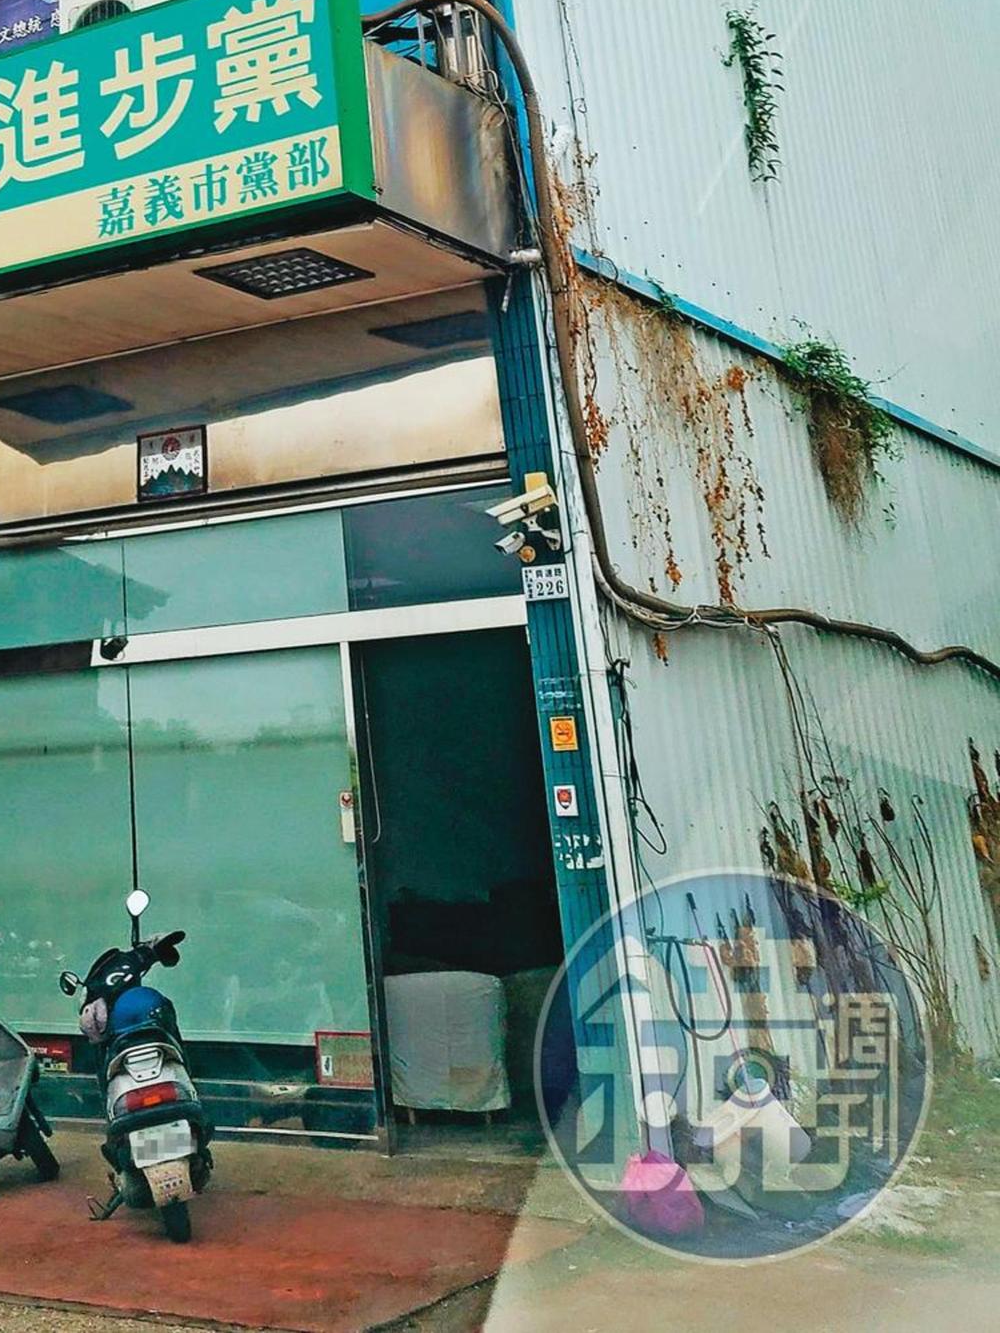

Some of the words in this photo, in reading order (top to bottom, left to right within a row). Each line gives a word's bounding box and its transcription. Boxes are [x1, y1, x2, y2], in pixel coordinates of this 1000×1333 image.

[95, 136, 331, 241] 嘉義市黨部
[536, 579, 565, 596] 226
